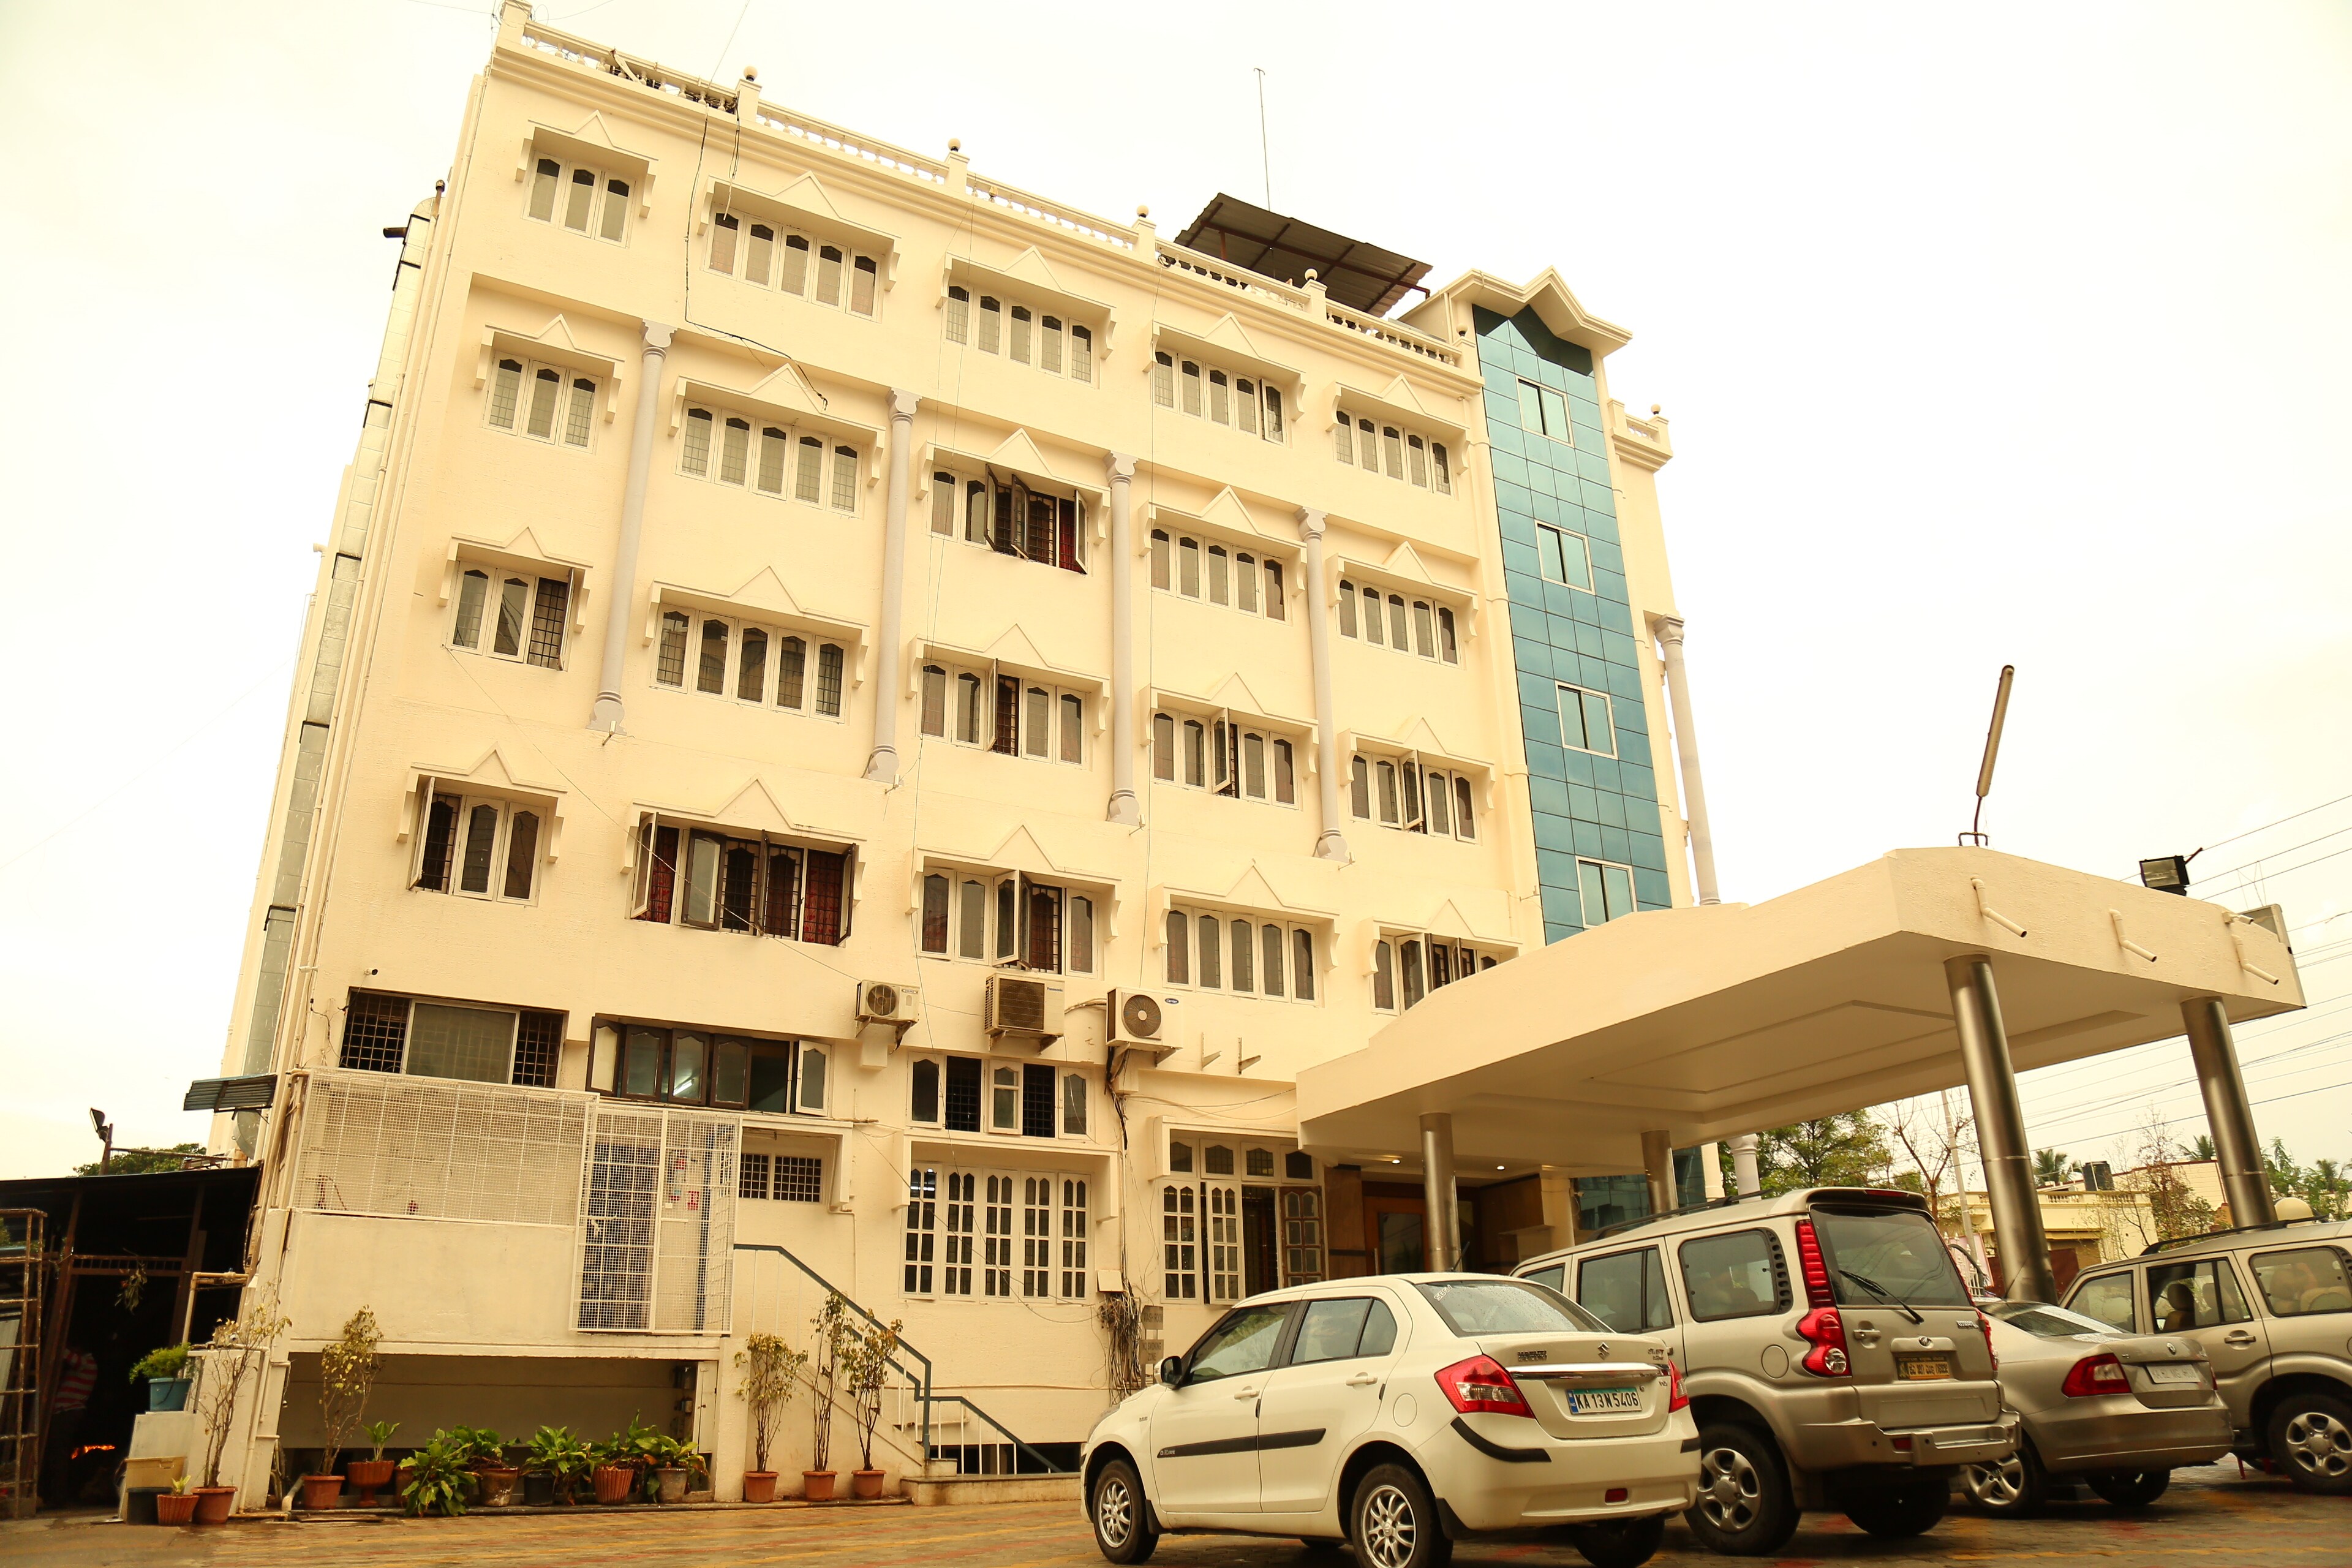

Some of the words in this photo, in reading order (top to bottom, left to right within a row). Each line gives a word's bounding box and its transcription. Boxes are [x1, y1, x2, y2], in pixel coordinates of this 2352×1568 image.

[1144, 1313, 1153, 1322] WASH
[1142, 1342, 1147, 1351] NO
[1147, 1342, 1161, 1351] SMOKING
[1148, 1352, 1156, 1361] ZONE
[1575, 1394, 1591, 1409] KA
[1591, 1393, 1605, 1408] 13
[1604, 1393, 1613, 1408] N
[1612, 1392, 1638, 1407] 5406
